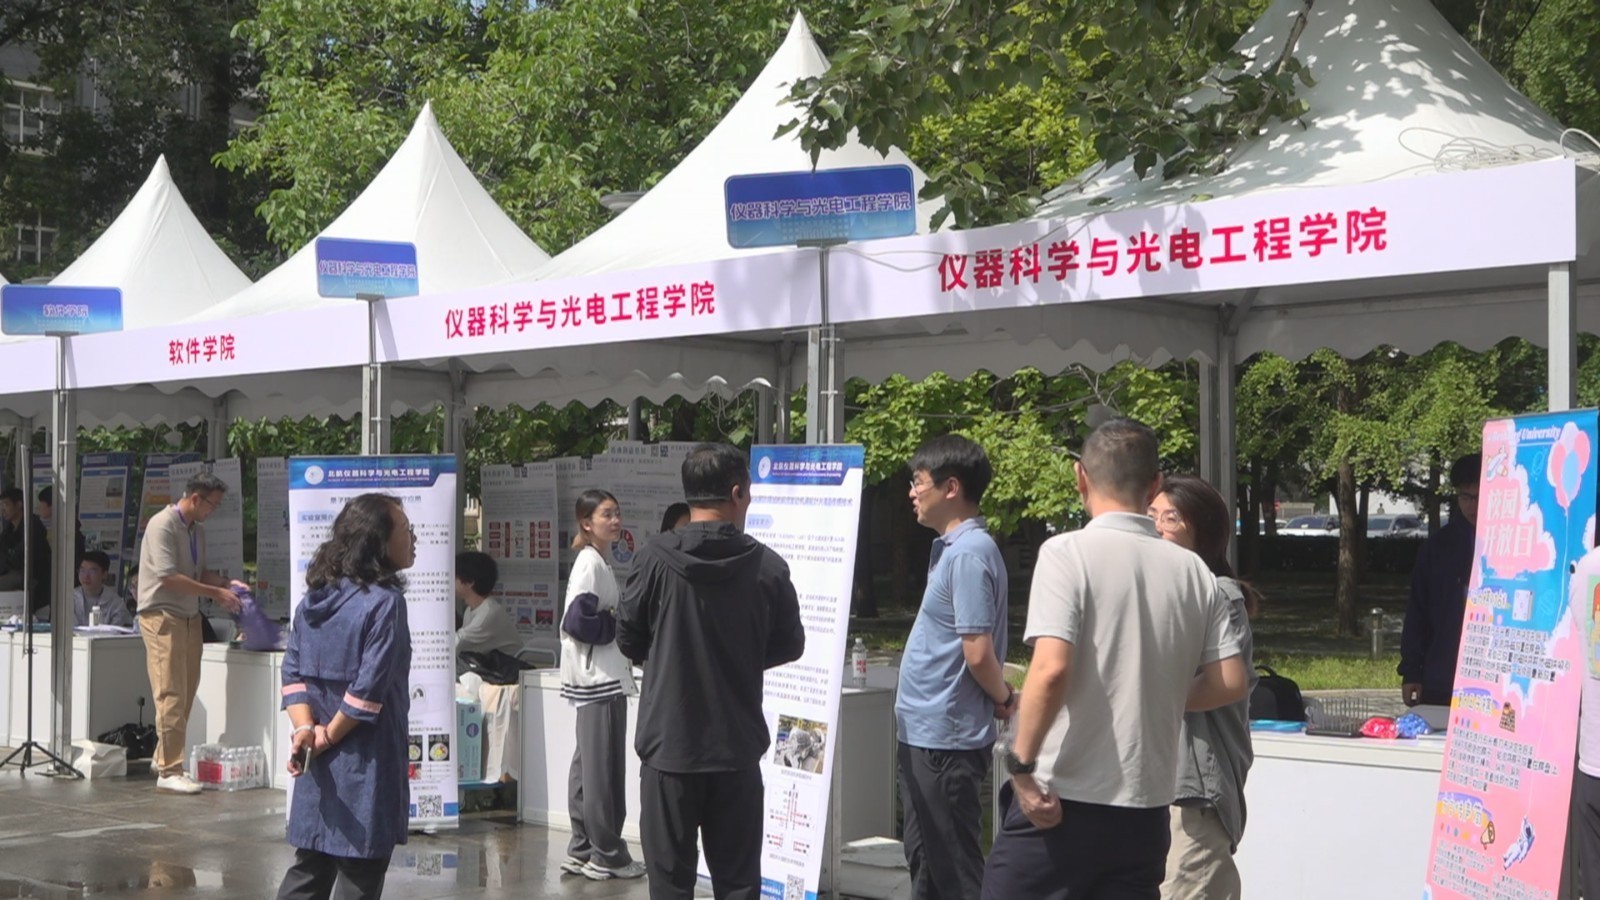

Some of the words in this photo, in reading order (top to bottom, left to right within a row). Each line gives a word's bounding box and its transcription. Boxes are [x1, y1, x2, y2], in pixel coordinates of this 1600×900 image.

[729, 191, 912, 221] 仪器科学与光电工程学院
[937, 206, 1389, 293] 仪器科学与光电工程学院
[445, 281, 716, 339] 仪器科学与光电工程学院
[168, 333, 236, 365] 软件学院
[1486, 488, 1518, 520] 校园
[1483, 524, 1535, 557] 开放日
